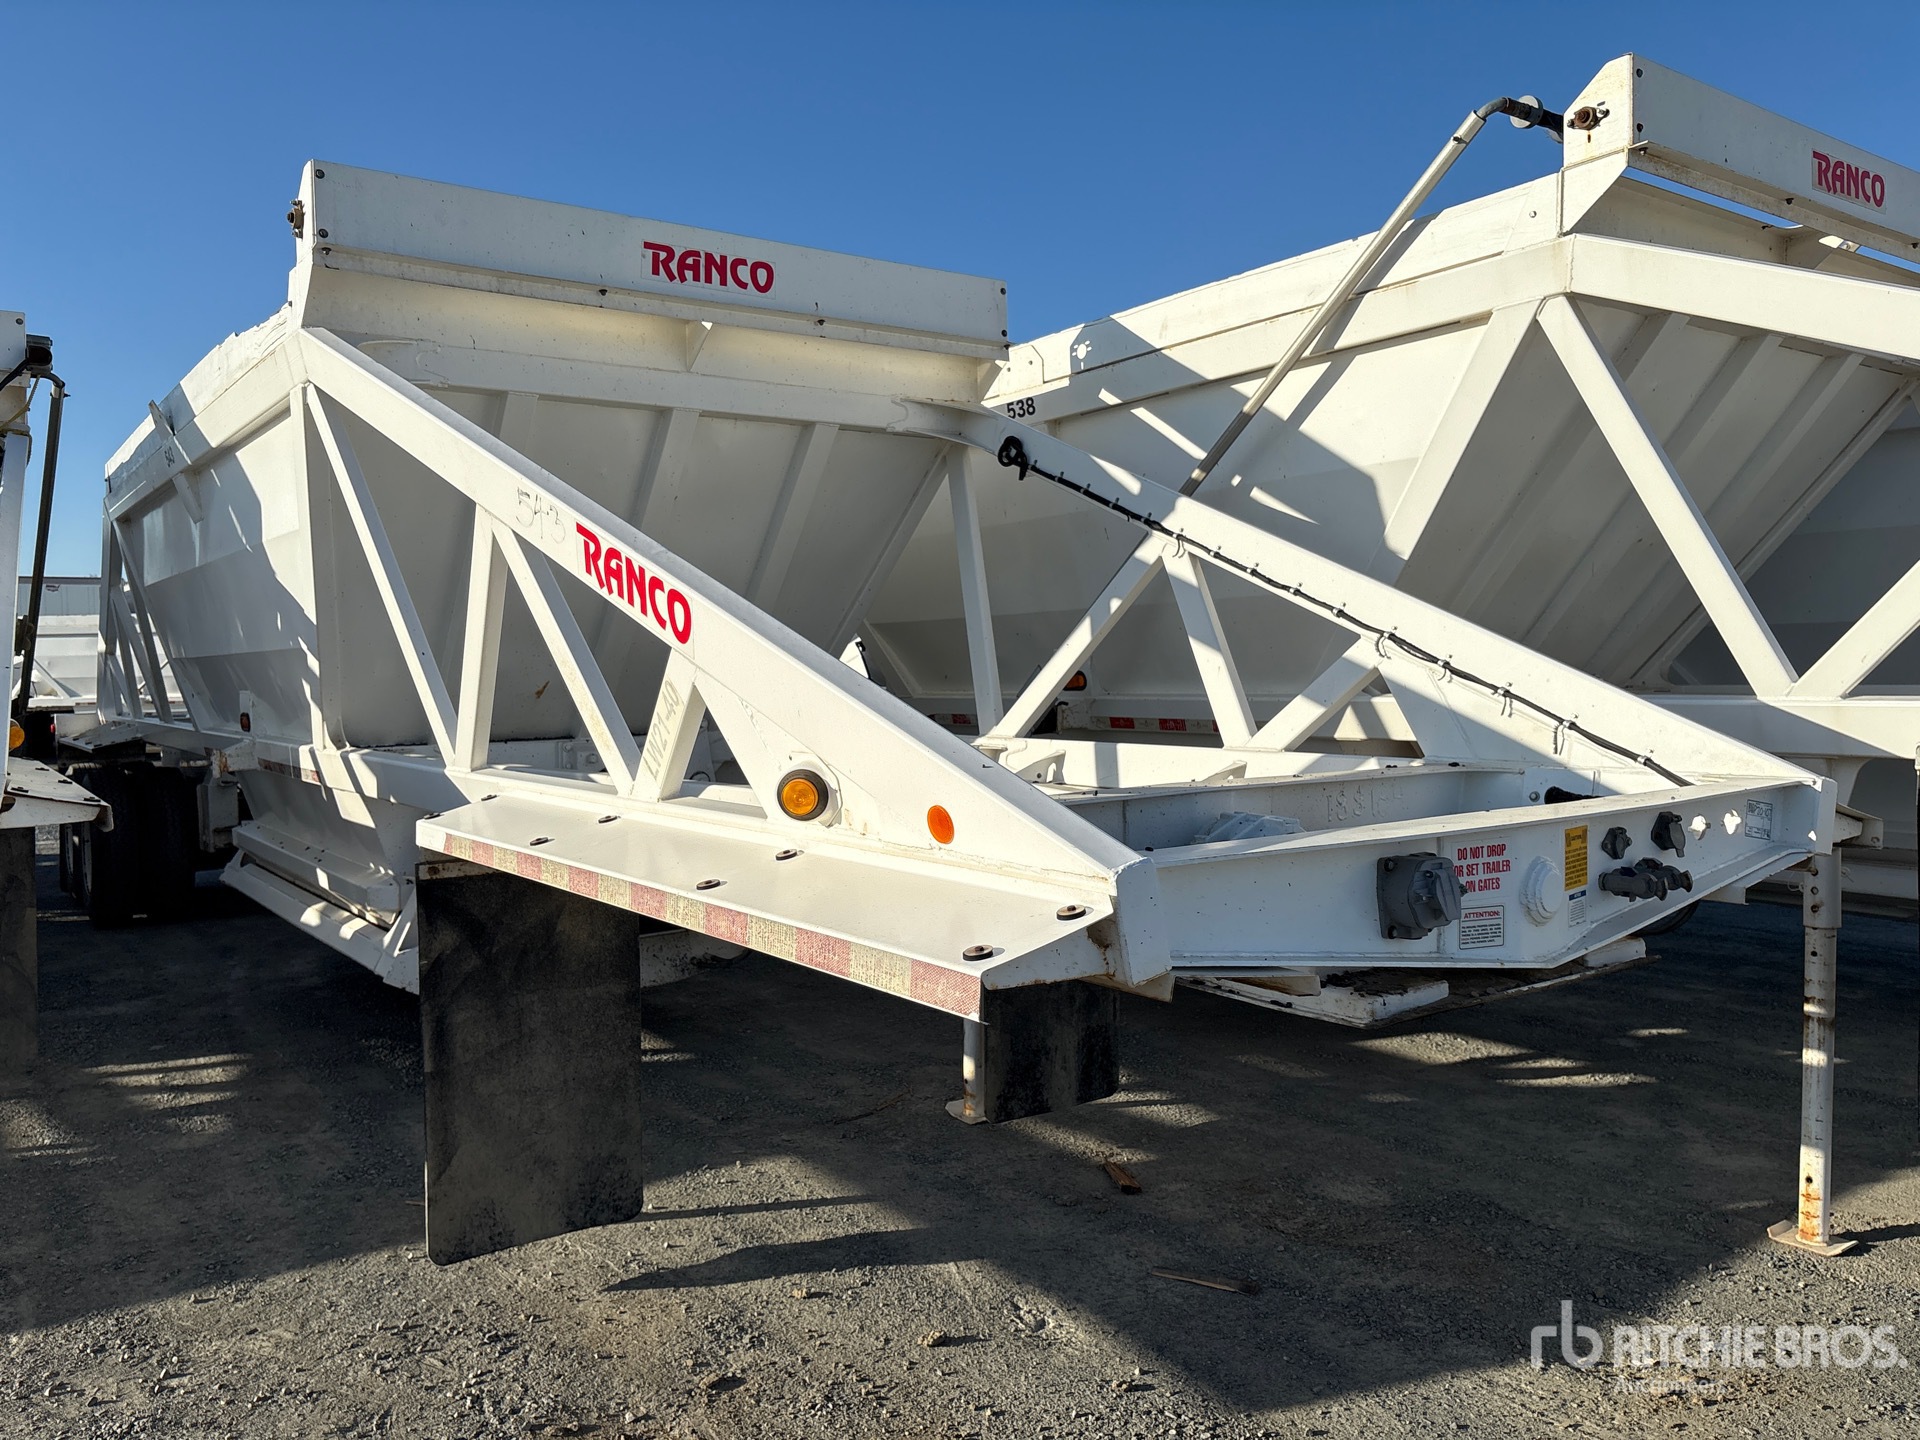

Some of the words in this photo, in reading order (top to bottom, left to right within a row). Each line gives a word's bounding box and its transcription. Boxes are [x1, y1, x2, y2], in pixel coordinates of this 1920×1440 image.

[1813, 150, 1885, 207] RANCO
[643, 241, 774, 293] RANCO
[1006, 397, 1036, 419] 538
[515, 486, 566, 544] 543
[576, 522, 691, 645] RANCO
[1454, 865, 1464, 877] OR
[1466, 863, 1479, 877] SET
[1481, 859, 1511, 875] TRAILER
[1457, 847, 1468, 861] DO
[1469, 846, 1484, 859] NOT
[1486, 843, 1507, 857] DROP
[1477, 877, 1500, 892] GATES
